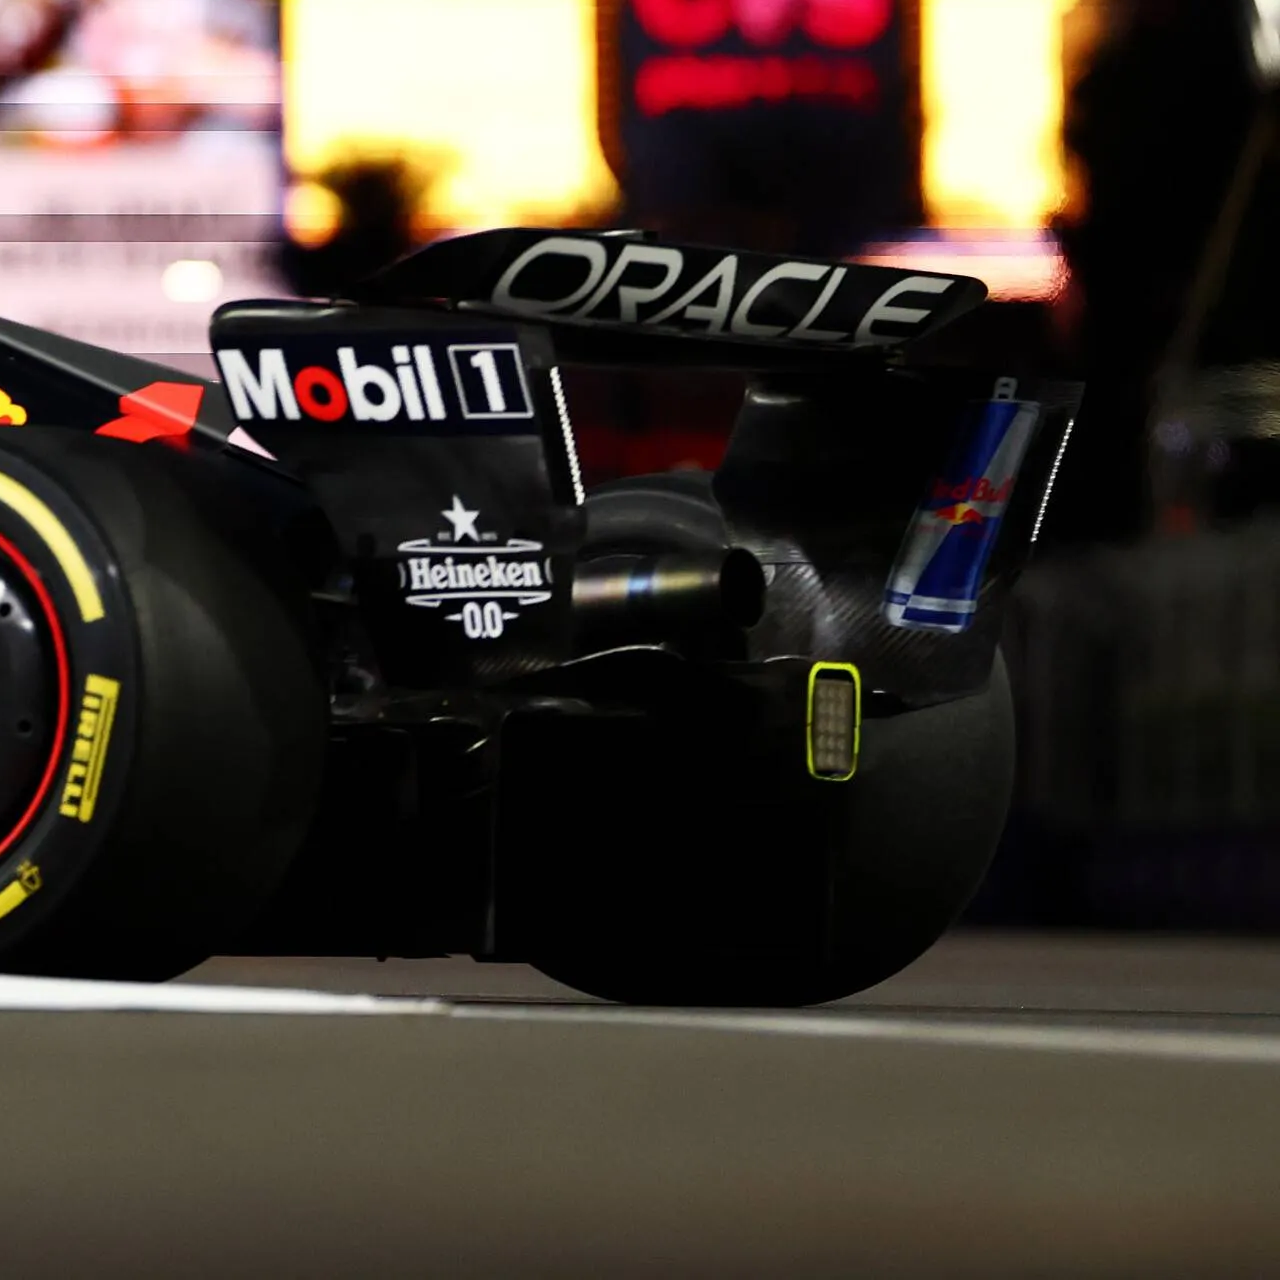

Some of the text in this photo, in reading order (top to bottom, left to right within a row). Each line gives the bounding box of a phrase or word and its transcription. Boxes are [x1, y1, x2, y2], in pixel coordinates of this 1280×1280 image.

[493, 237, 954, 343] ORACLE
[216, 345, 508, 422] Mobil 1
[407, 554, 544, 591] Heineken
